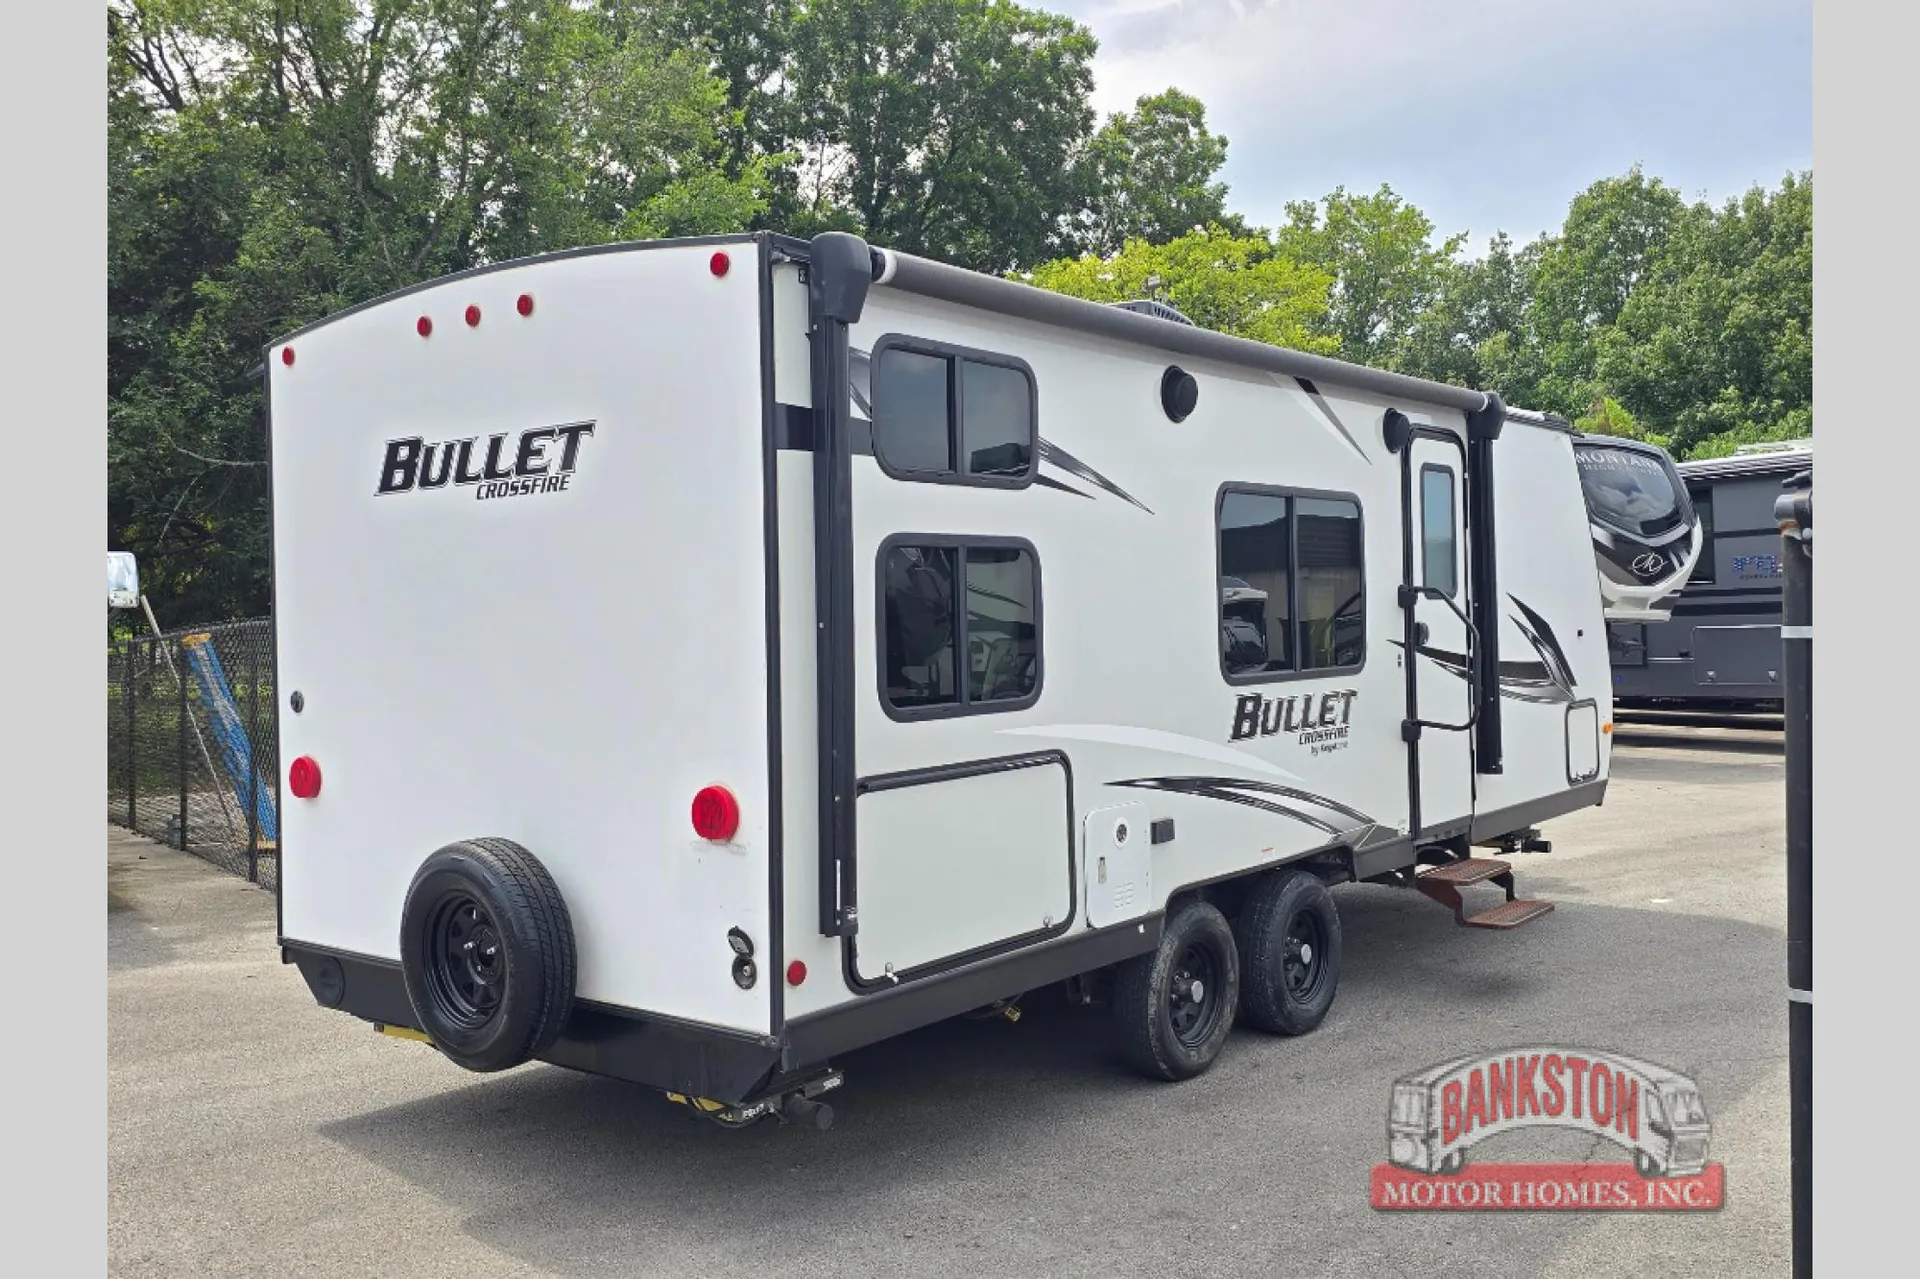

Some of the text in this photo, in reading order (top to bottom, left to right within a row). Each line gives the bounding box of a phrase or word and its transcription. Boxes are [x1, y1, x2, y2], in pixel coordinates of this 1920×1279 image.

[374, 419, 597, 497] BULLET
[476, 474, 571, 500] CROSSFIRE
[1228, 688, 1358, 743] BULLET
[1299, 725, 1350, 745] CROSSFIRE
